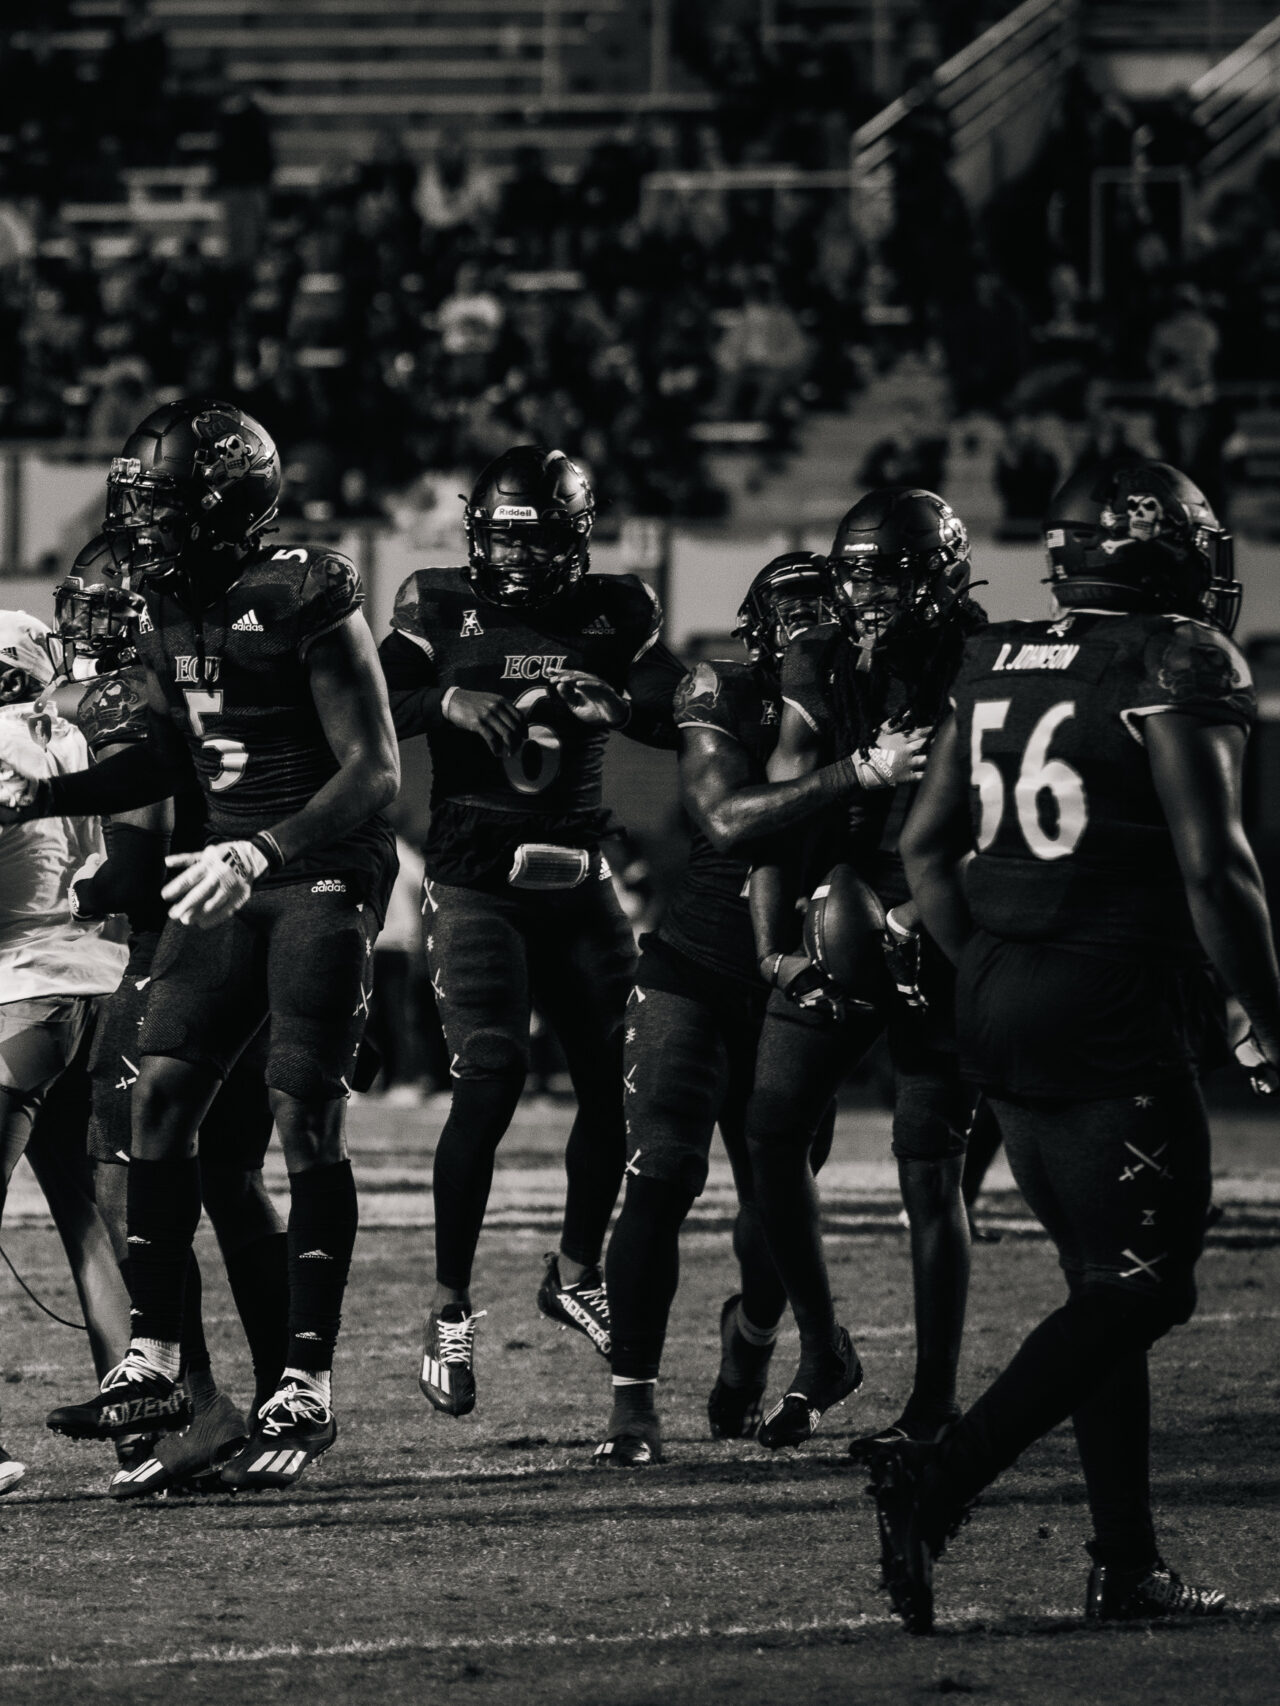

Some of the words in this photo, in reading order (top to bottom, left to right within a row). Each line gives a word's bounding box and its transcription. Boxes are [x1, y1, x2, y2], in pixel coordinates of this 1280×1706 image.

[499, 507, 532, 517] Riddell
[271, 548, 309, 564] 5
[231, 622, 265, 632] adidas
[460, 609, 484, 638] A
[501, 655, 568, 680] ECU
[182, 688, 249, 793] 5
[503, 685, 562, 796] 6
[970, 700, 1090, 861] 56
[310, 882, 347, 893] adidas
[556, 1293, 612, 1355] ADIZERO
